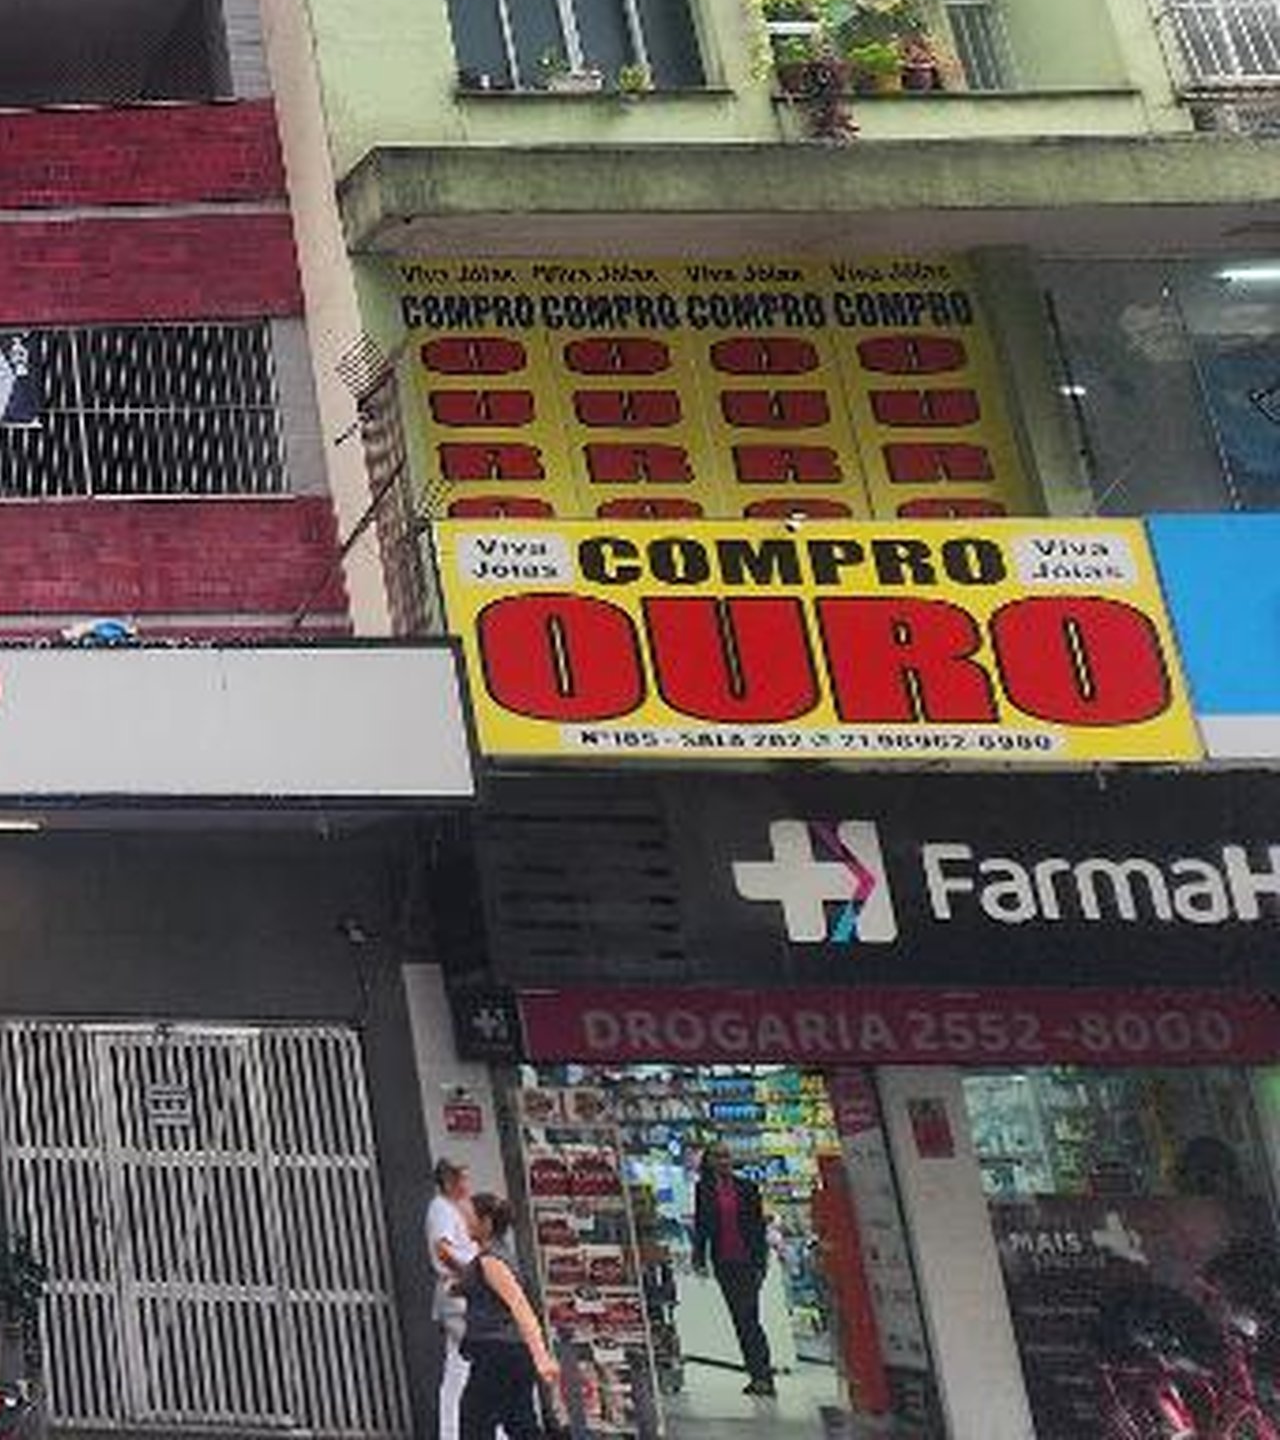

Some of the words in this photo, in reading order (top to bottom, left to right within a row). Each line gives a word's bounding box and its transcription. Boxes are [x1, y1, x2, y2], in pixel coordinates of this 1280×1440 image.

[402, 294, 536, 329] COMPRO
[540, 294, 681, 329] COMPRO
[686, 293, 827, 328] COMPRO
[833, 292, 974, 327] COMPRO
[474, 538, 548, 557] Viva
[577, 536, 1008, 586] COMPRO
[1031, 538, 1111, 557] Viva
[475, 591, 1173, 727] OURO
[921, 842, 1280, 924] FarmaH
[582, 1010, 898, 1052] DROGARIA
[1009, 1231, 1082, 1256] MAIS
